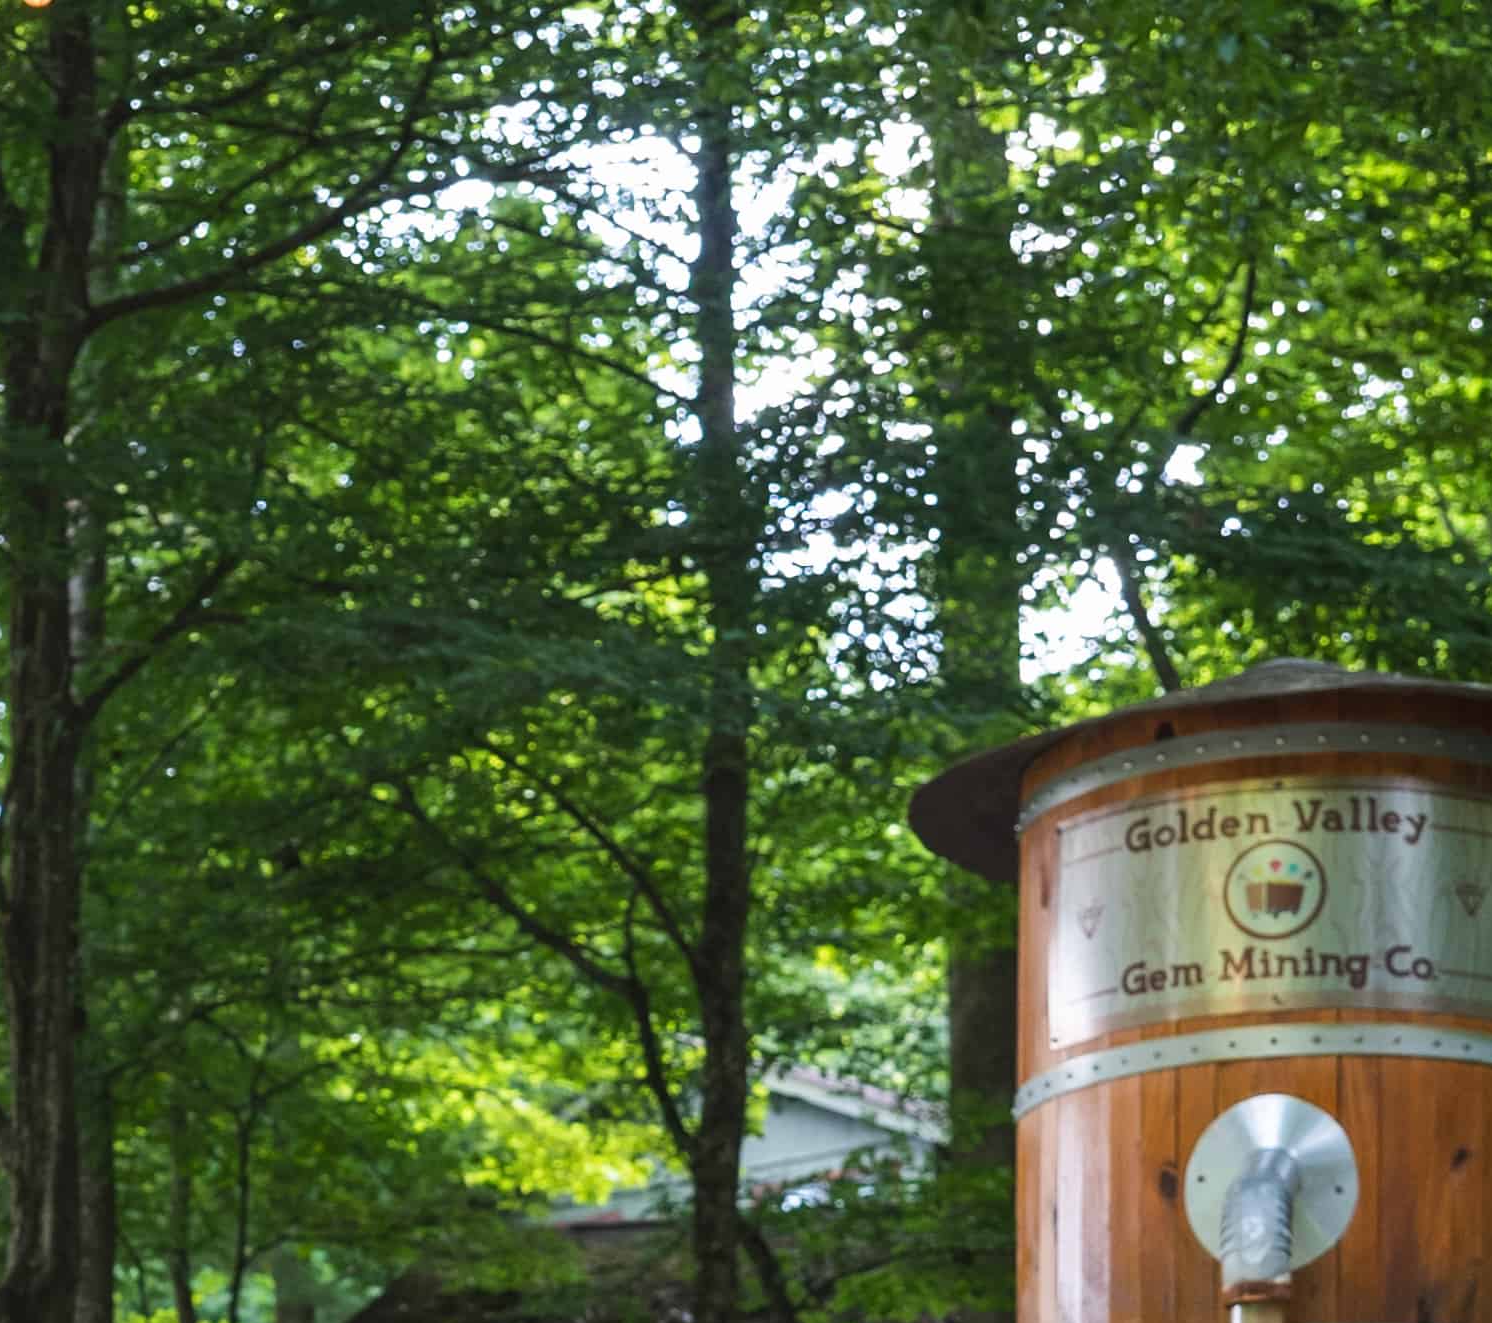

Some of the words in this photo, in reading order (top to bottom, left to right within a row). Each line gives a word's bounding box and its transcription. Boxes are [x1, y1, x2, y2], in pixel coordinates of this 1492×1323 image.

[1125, 806, 1271, 852] Golden
[1293, 797, 1427, 845] Valley
[1121, 961, 1203, 996] Gem
[1219, 946, 1370, 989] Mining
